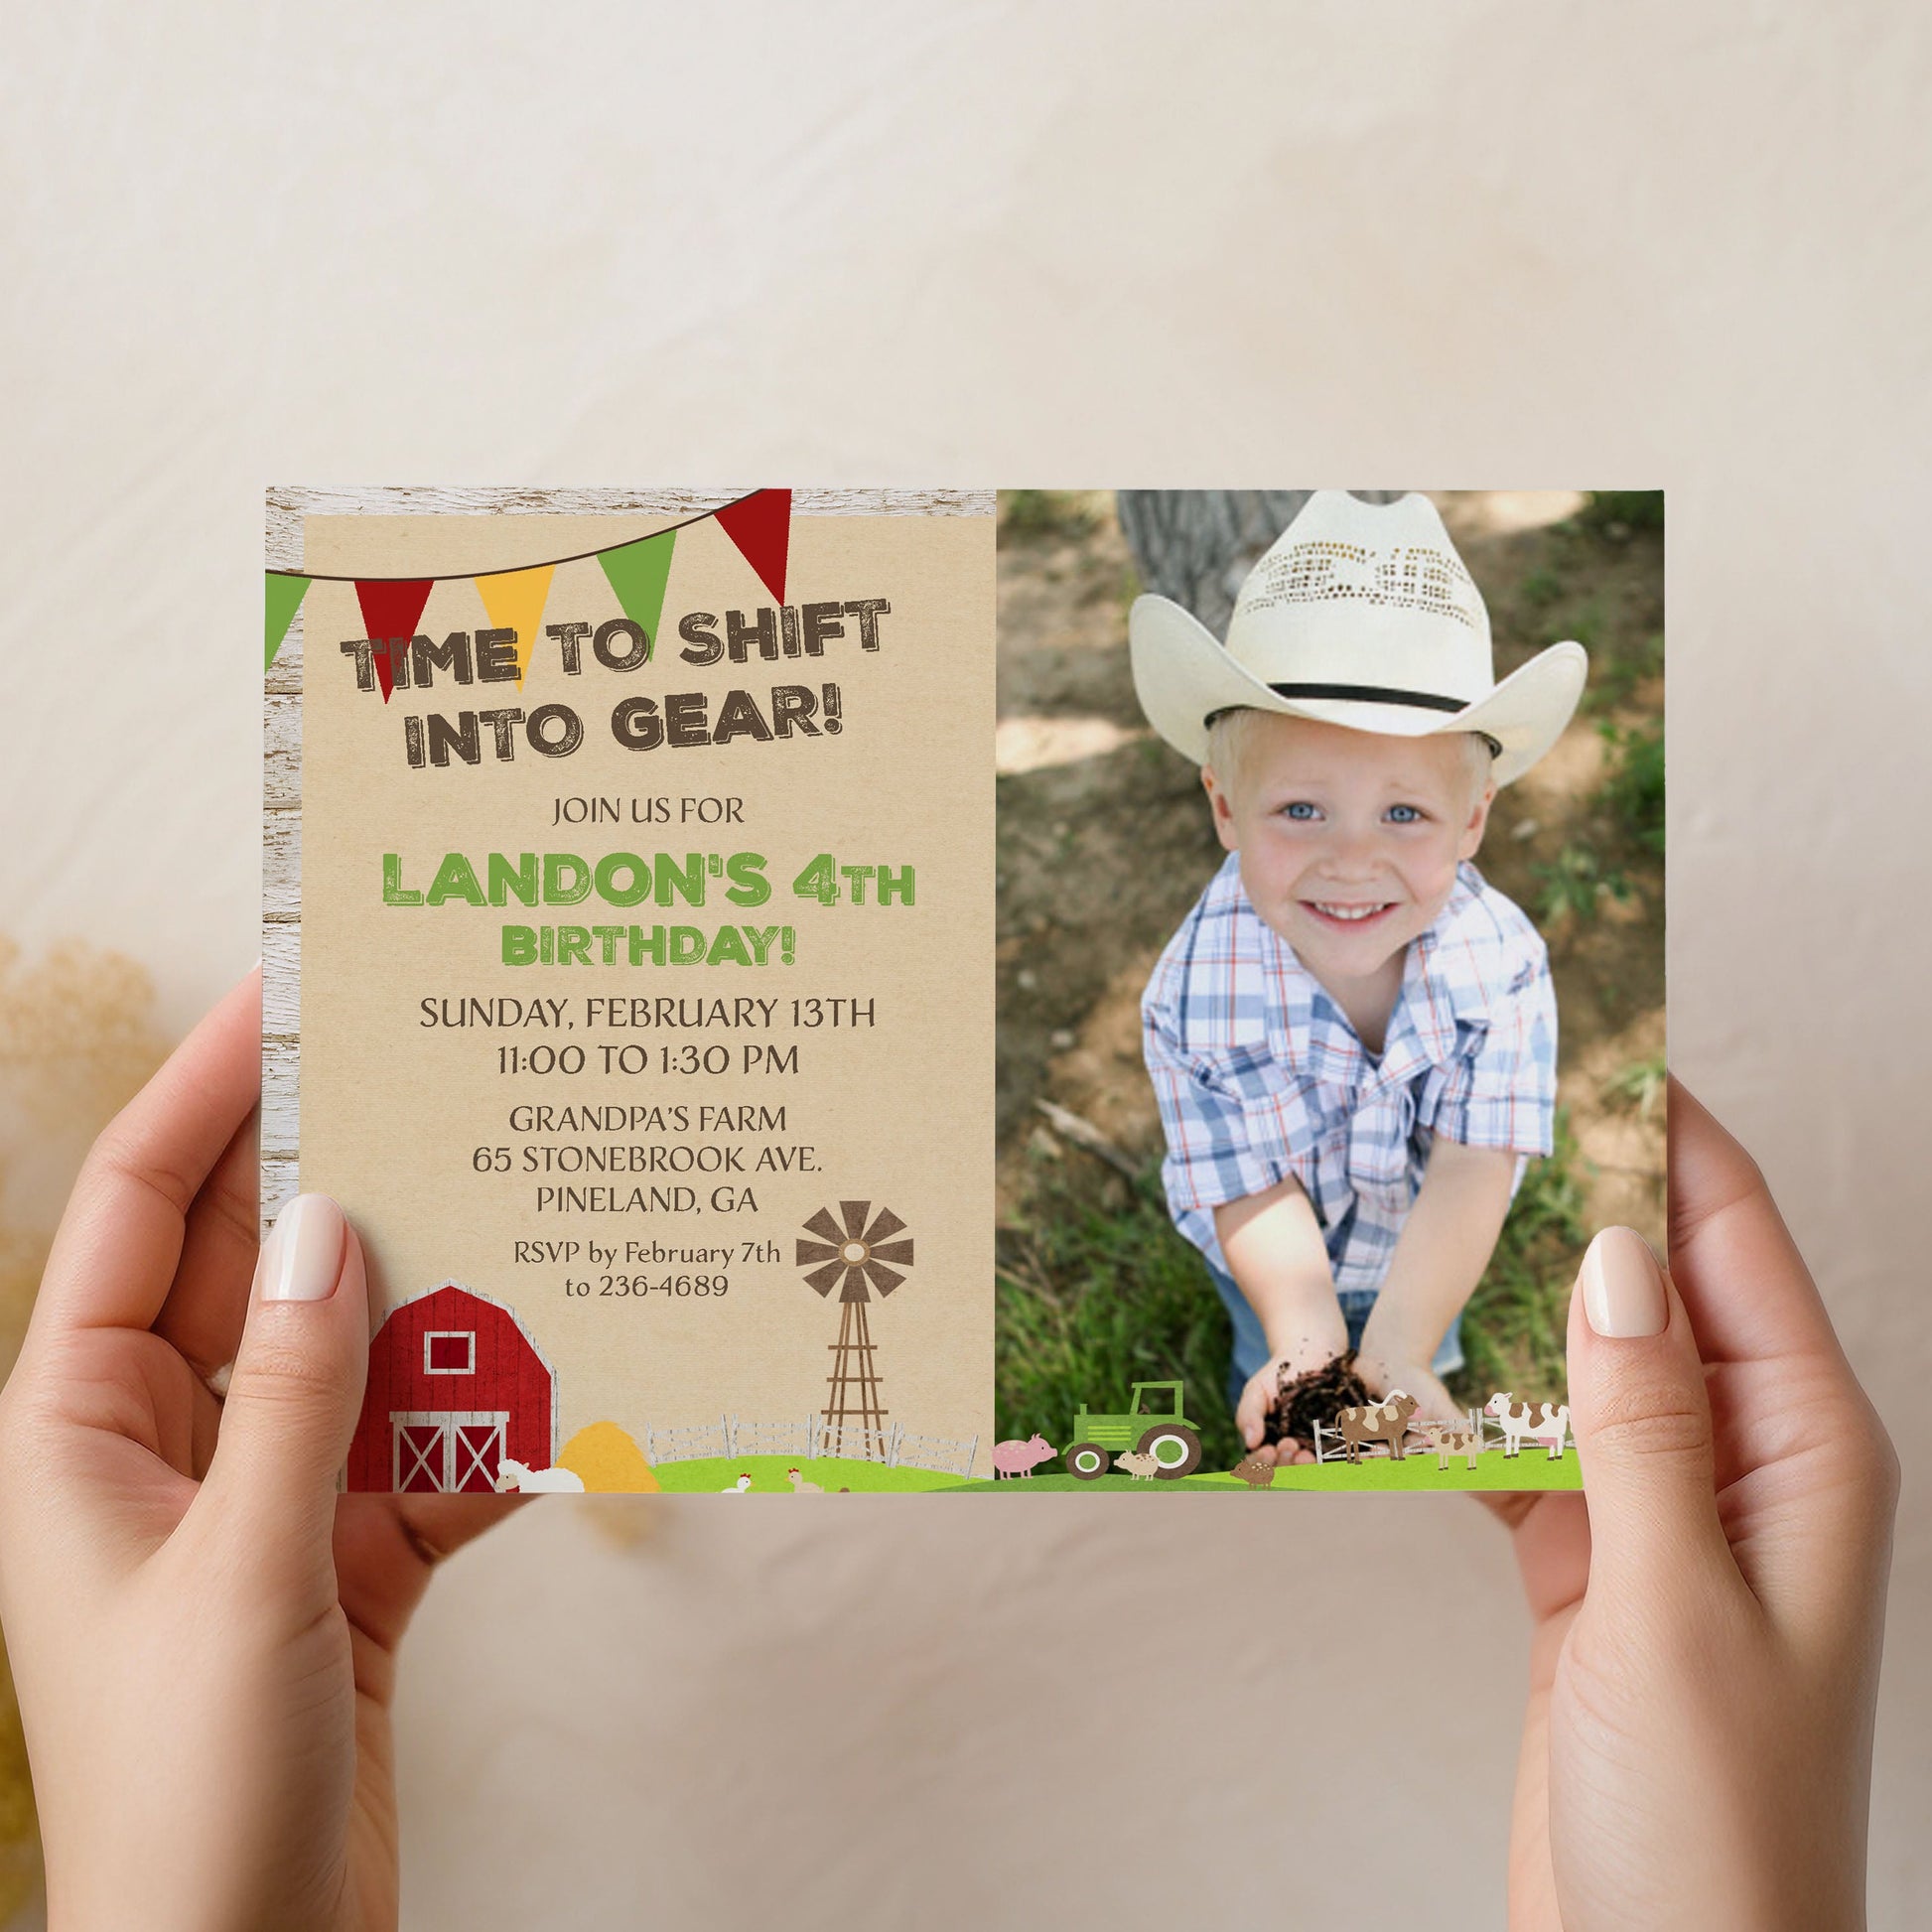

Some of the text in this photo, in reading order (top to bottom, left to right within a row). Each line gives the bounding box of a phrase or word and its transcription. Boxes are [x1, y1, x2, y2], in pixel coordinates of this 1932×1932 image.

[340, 597, 891, 693] TIME TO SHIFT
[403, 682, 843, 768] INTO GEAR!
[551, 797, 746, 827] JOIN US FOR
[381, 851, 916, 909] LANDON'S 4TH
[500, 923, 797, 967] BIRTHDAY!
[419, 997, 875, 1031] SUNDAY, FEBRUARY 13TH
[497, 1044, 799, 1075] 11:00 TO 1:30 PM
[508, 1105, 786, 1132] GRANDPA’S FARM
[473, 1146, 822, 1173] 65 STONEBROOK AVE.
[537, 1185, 759, 1215] PINELAND, GA
[514, 1239, 780, 1270] RSVP by February 7th
[565, 1275, 729, 1298] to 236-4689
